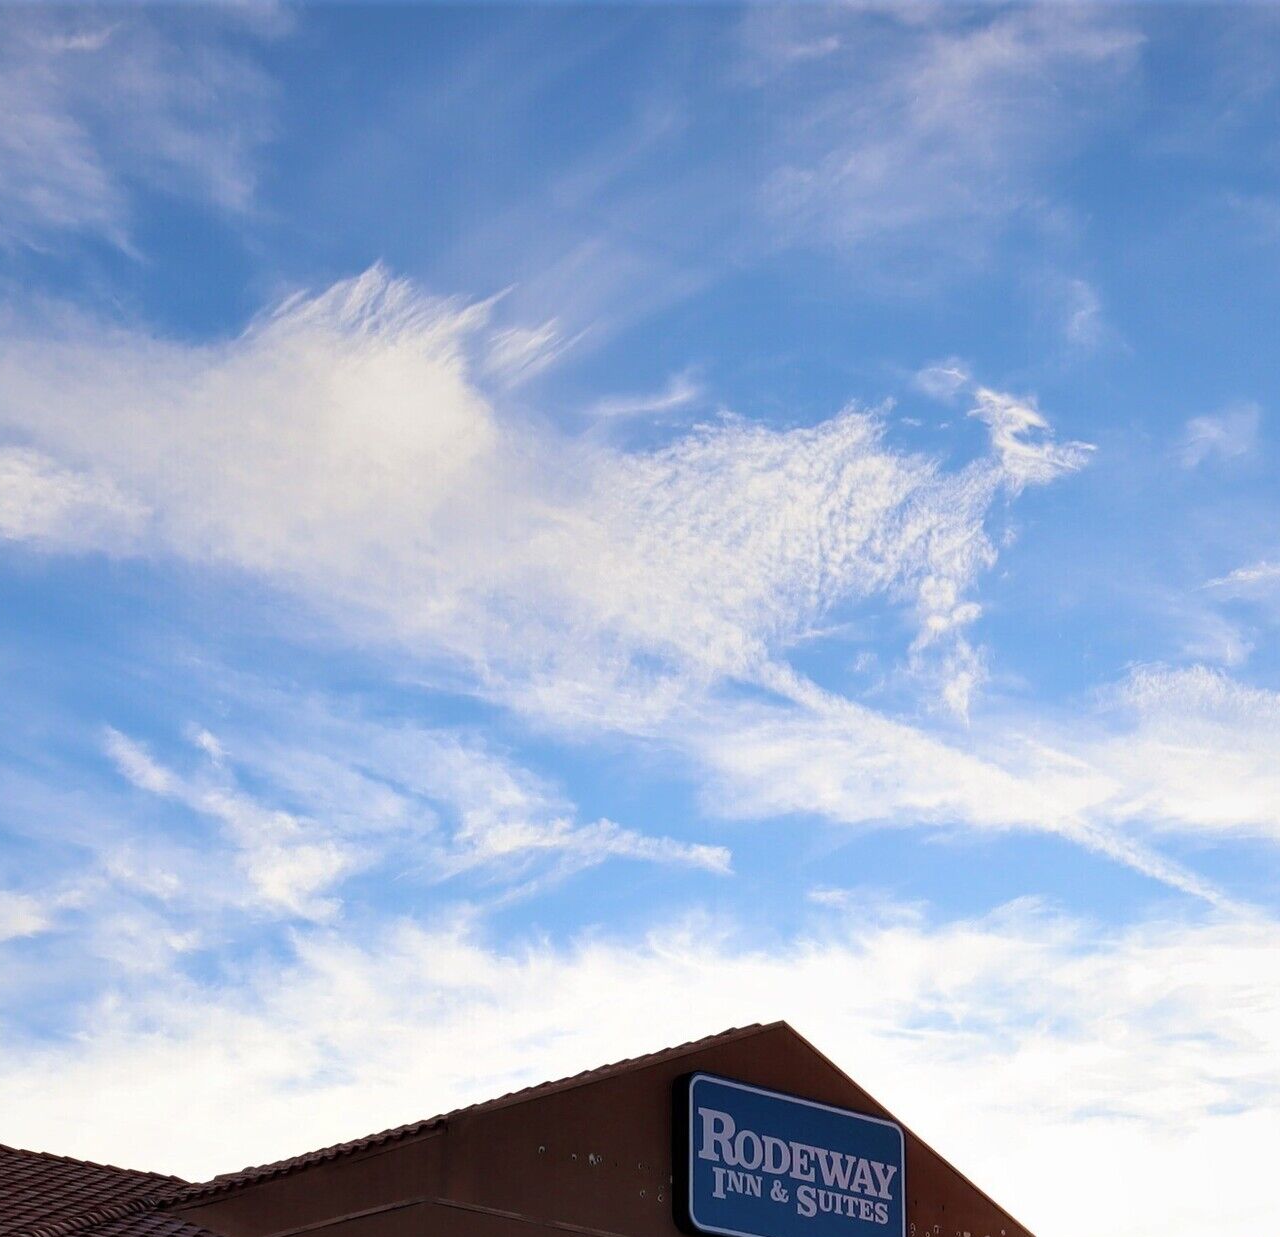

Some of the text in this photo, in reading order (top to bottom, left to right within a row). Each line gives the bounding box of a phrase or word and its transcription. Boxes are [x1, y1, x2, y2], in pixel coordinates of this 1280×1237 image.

[698, 1107, 898, 1200] RODEWAY
[712, 1167, 889, 1225] INN & SUITES
